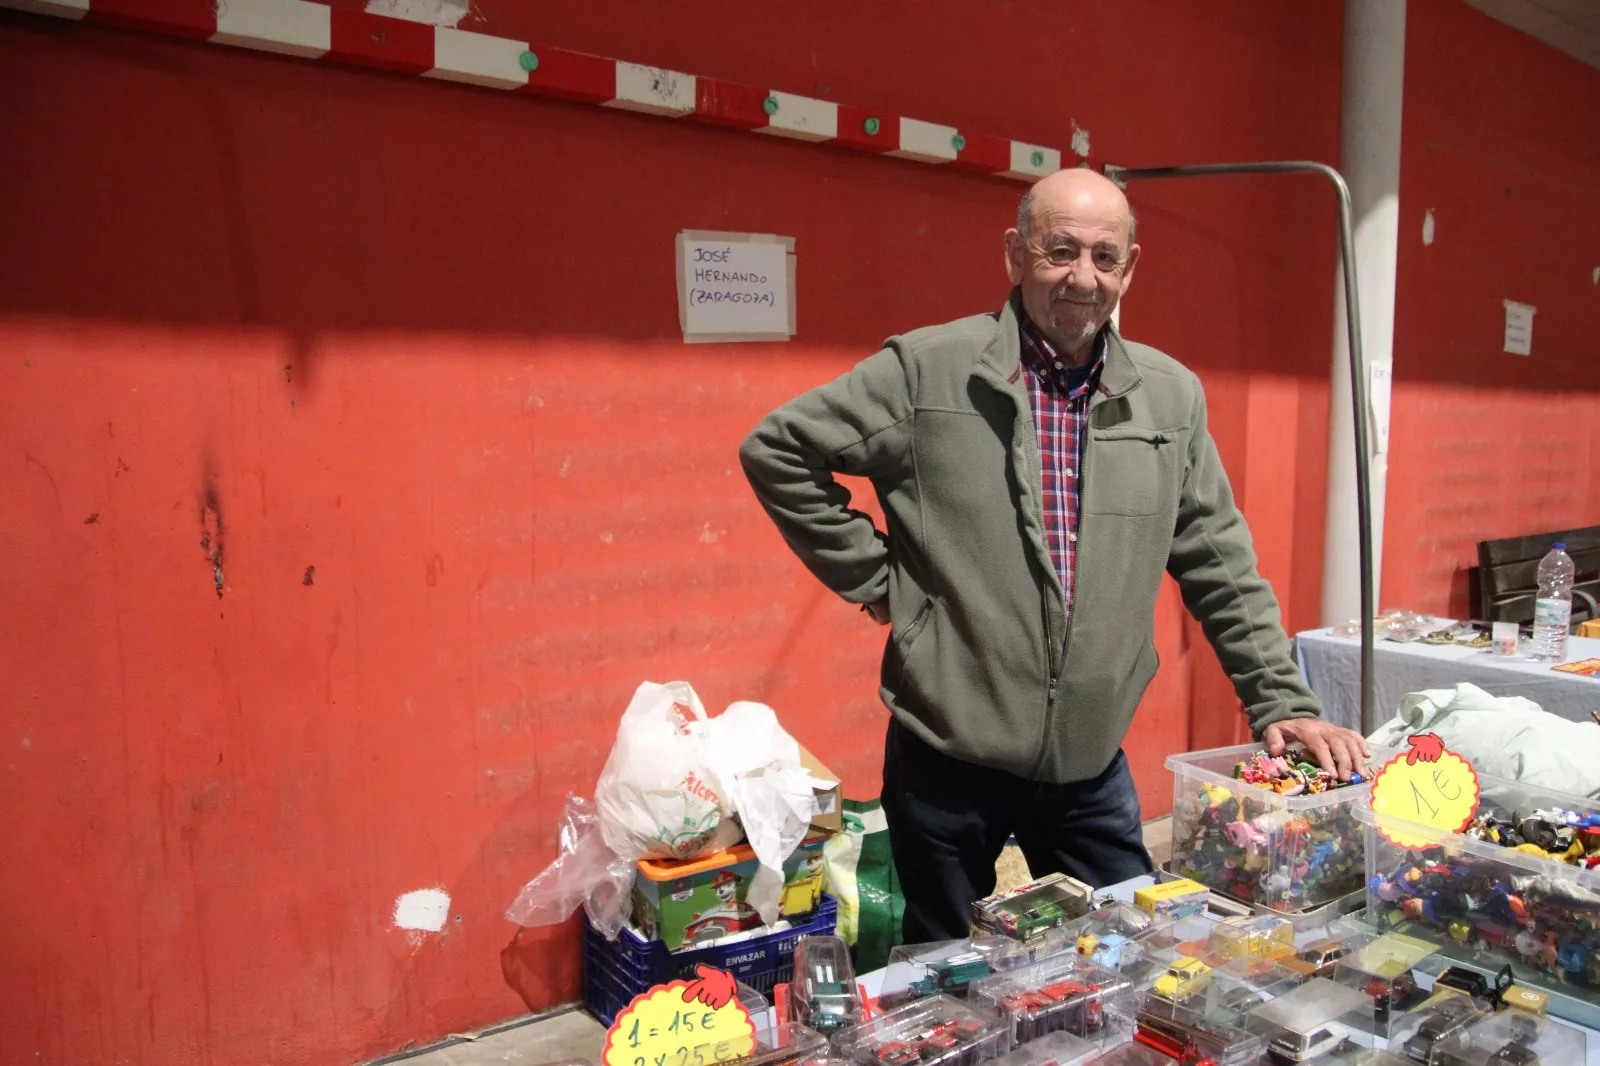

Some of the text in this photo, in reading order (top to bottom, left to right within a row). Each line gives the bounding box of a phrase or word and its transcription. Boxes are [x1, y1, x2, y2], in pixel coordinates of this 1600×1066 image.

[694, 247, 731, 263] JOSÉ
[695, 268, 768, 284] HERNANDO
[1409, 769, 1462, 820] 1€
[725, 950, 766, 967] ENVAZAR
[627, 1018, 642, 1048] 1
[668, 1011, 716, 1036] 15€
